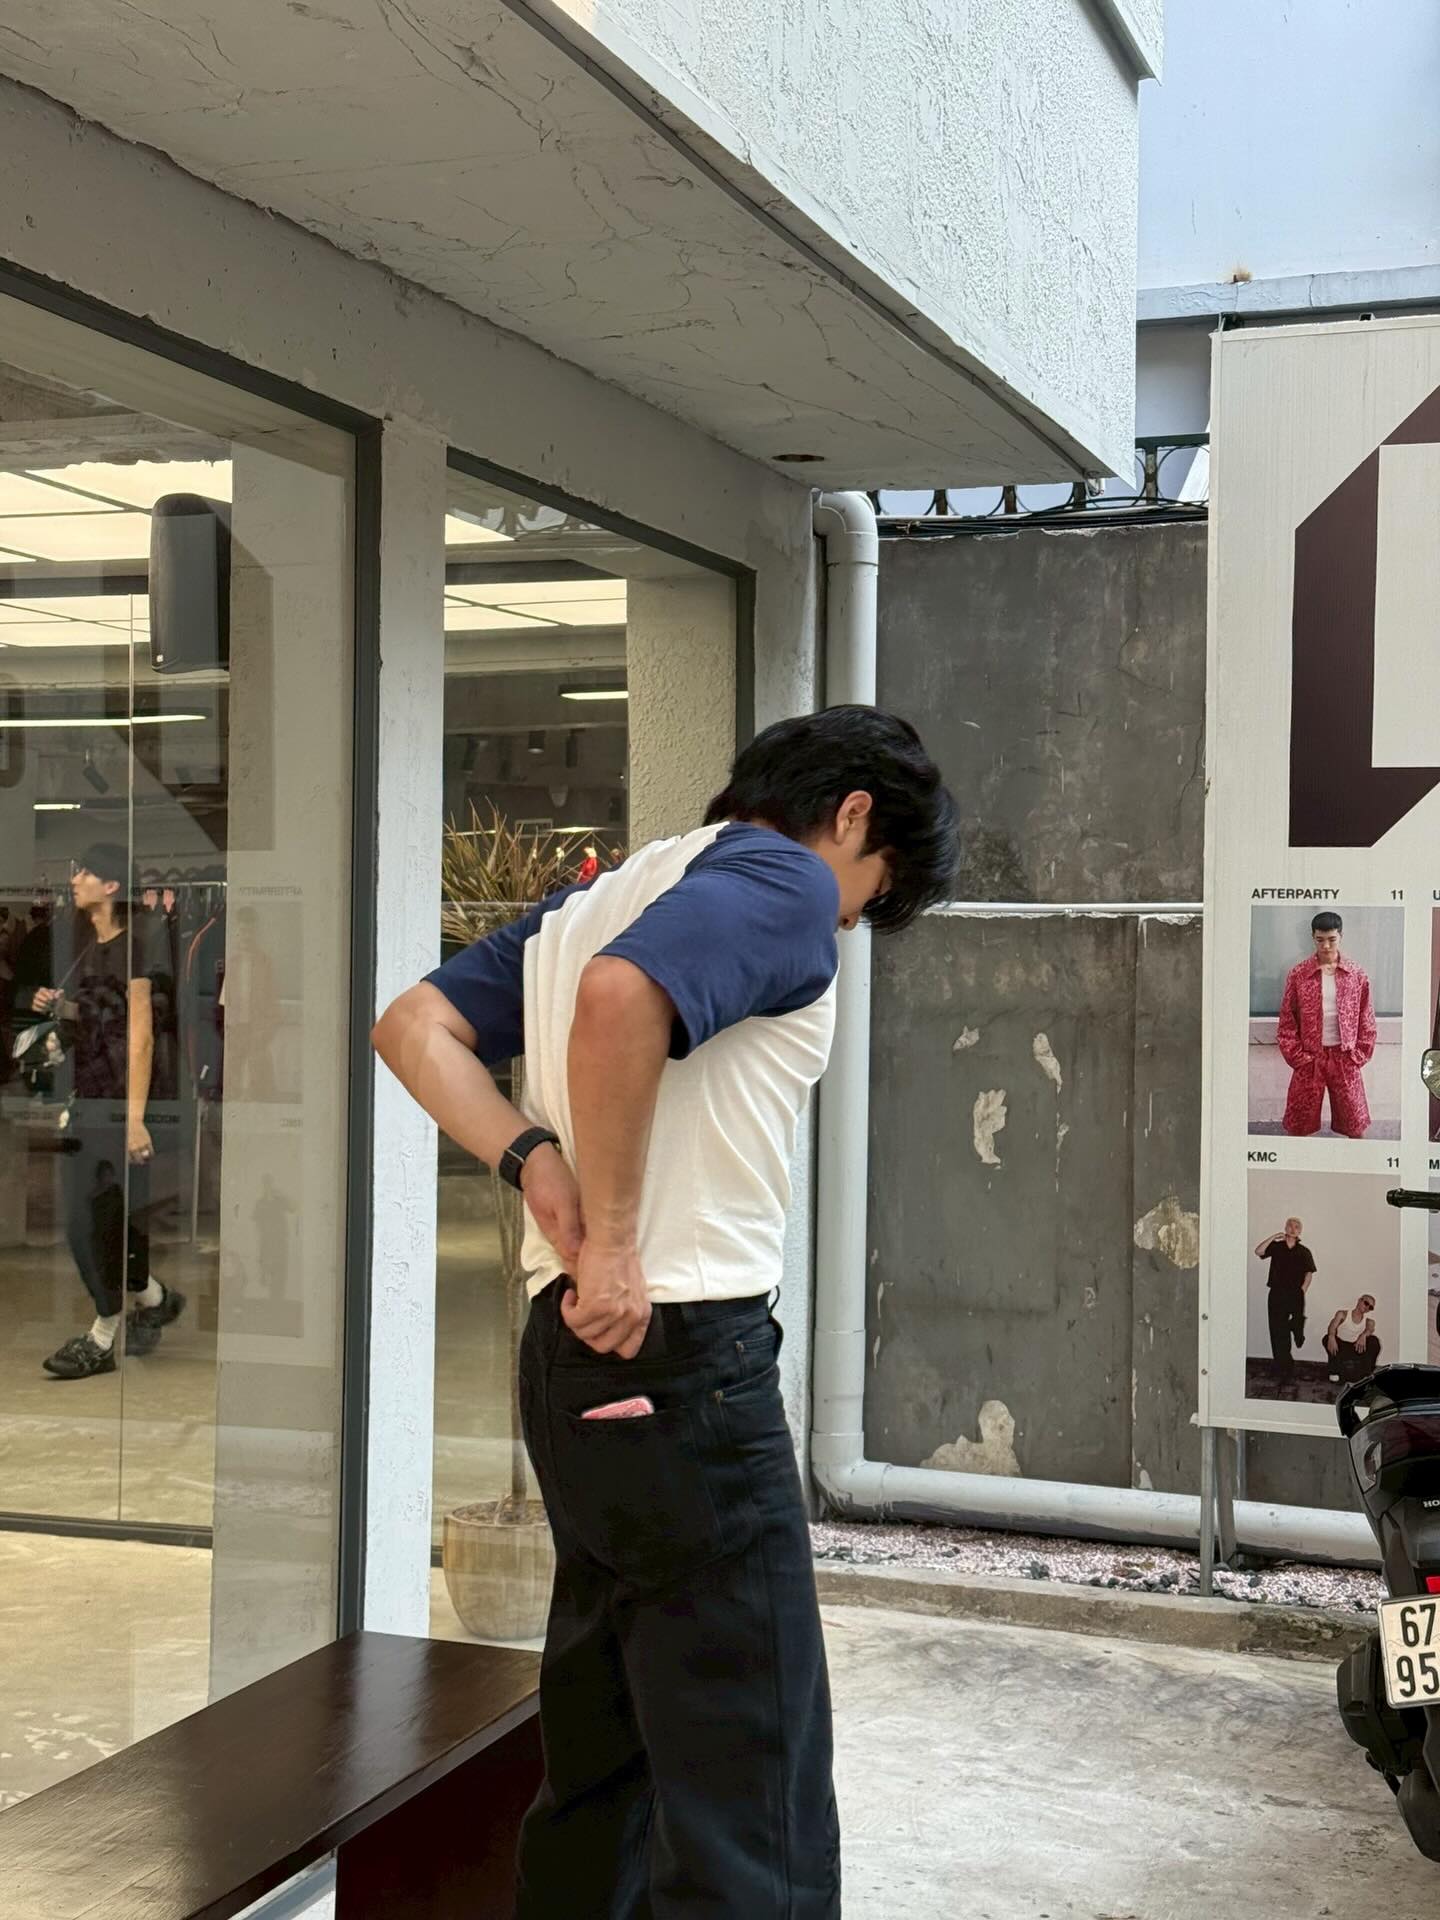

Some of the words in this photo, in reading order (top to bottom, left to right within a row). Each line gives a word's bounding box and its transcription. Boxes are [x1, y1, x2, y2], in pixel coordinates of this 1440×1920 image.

[1251, 888, 1340, 900] AFTERPARTY
[1391, 889, 1404, 900] 11
[1247, 1151, 1278, 1163] KMC
[1387, 1157, 1400, 1168] 11
[1400, 1603, 1436, 1647] 67
[1396, 1652, 1440, 1697] 95
